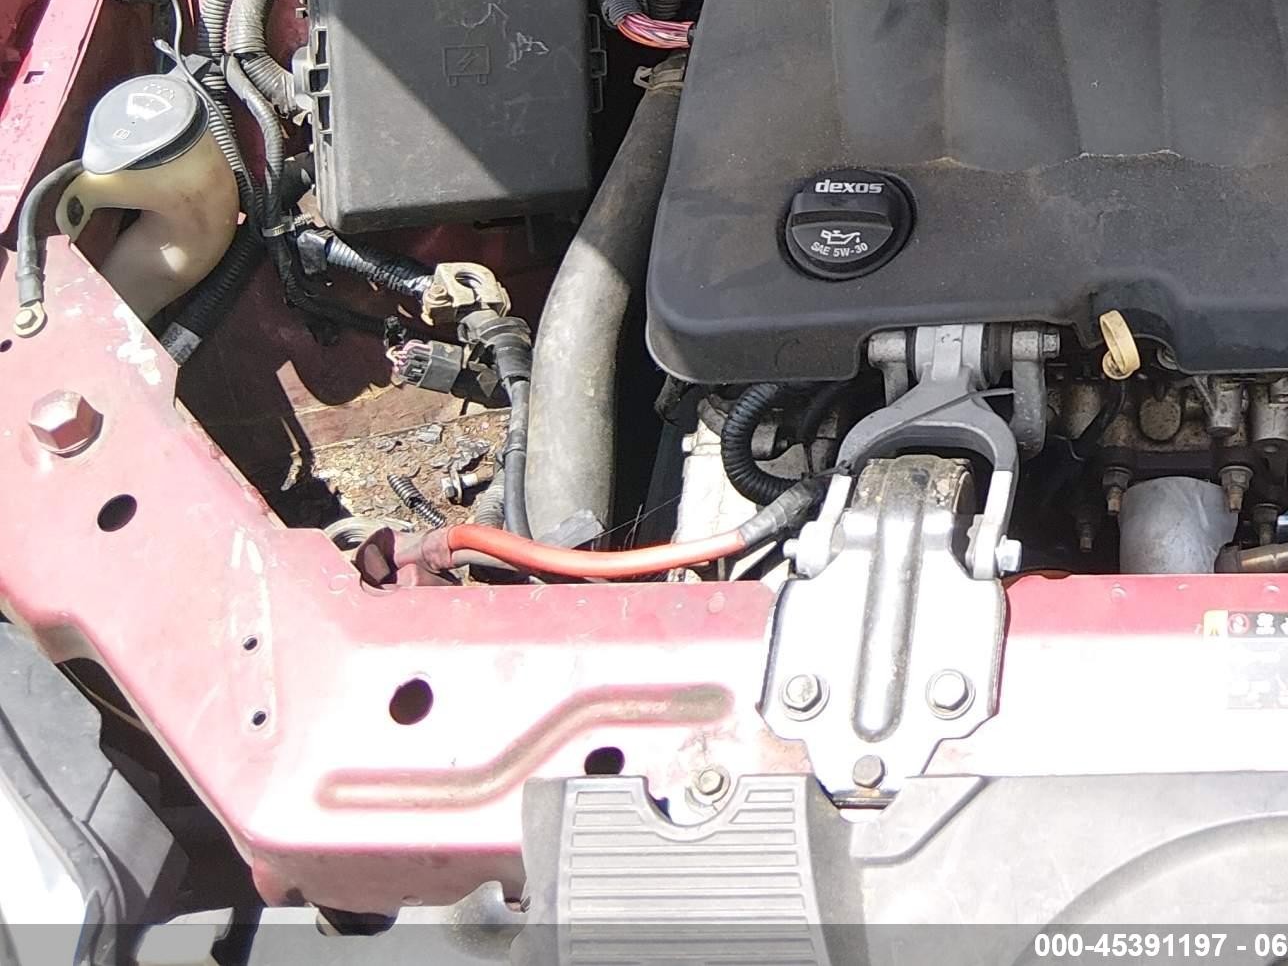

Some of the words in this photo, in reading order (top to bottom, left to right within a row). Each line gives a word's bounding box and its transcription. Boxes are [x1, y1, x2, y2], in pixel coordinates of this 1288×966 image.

[814, 178, 885, 194] dexos
[811, 241, 830, 256] SAE
[833, 242, 868, 258] 5W-30
